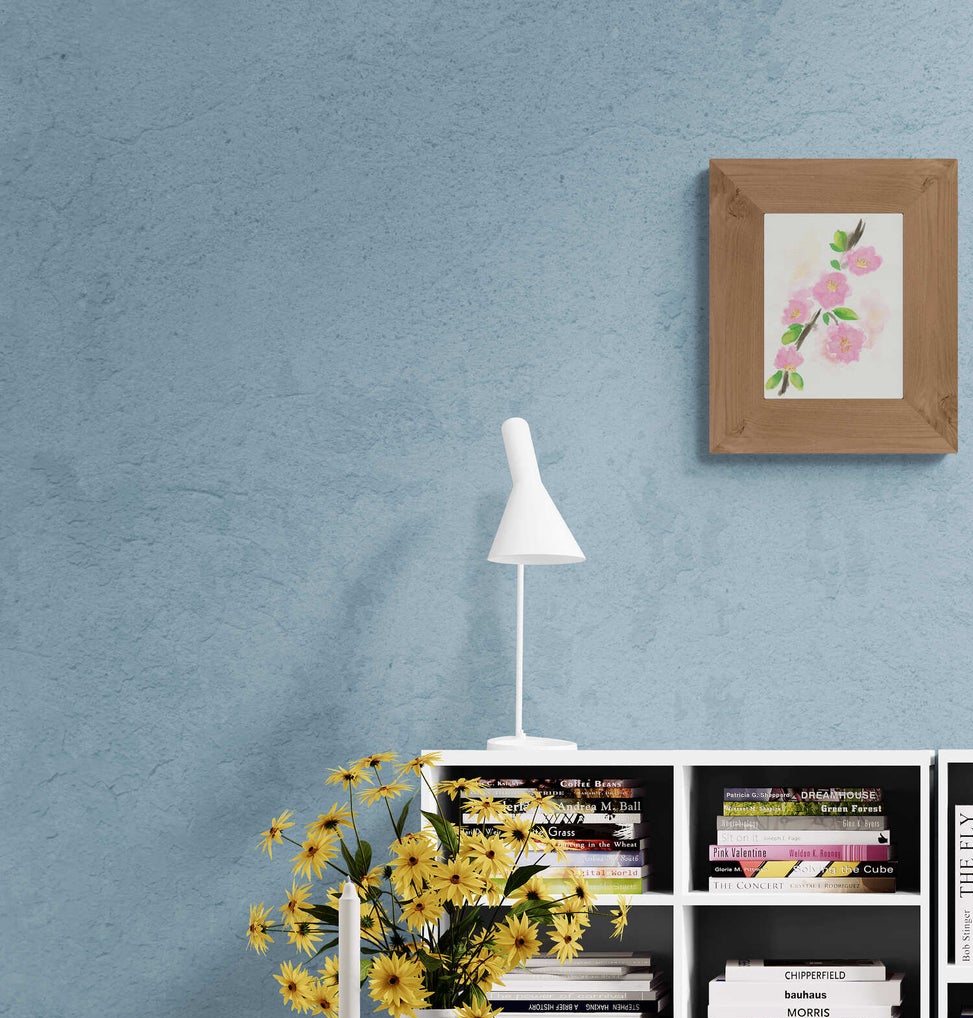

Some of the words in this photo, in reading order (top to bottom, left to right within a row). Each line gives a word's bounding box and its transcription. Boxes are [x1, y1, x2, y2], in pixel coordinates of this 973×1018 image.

[801, 791, 876, 799] DREAMHOUSE
[559, 802, 597, 811] Andrea
[601, 802, 616, 811] M.
[620, 801, 641, 811] Ball
[549, 827, 575, 837] Grass
[960, 813, 973, 850] FLY
[713, 848, 729, 858] Pink
[731, 848, 767, 858] Valentine
[841, 865, 860, 874] the
[864, 865, 894, 874] Cube
[960, 858, 973, 898] THE
[736, 881, 784, 890] CONCERT
[962, 910, 972, 941] Stinger
[962, 944, 971, 962] Bob
[785, 971, 846, 980] CHIPPERFIELD
[785, 990, 827, 999] bauhaus
[787, 1008, 830, 1017] MORRIS
